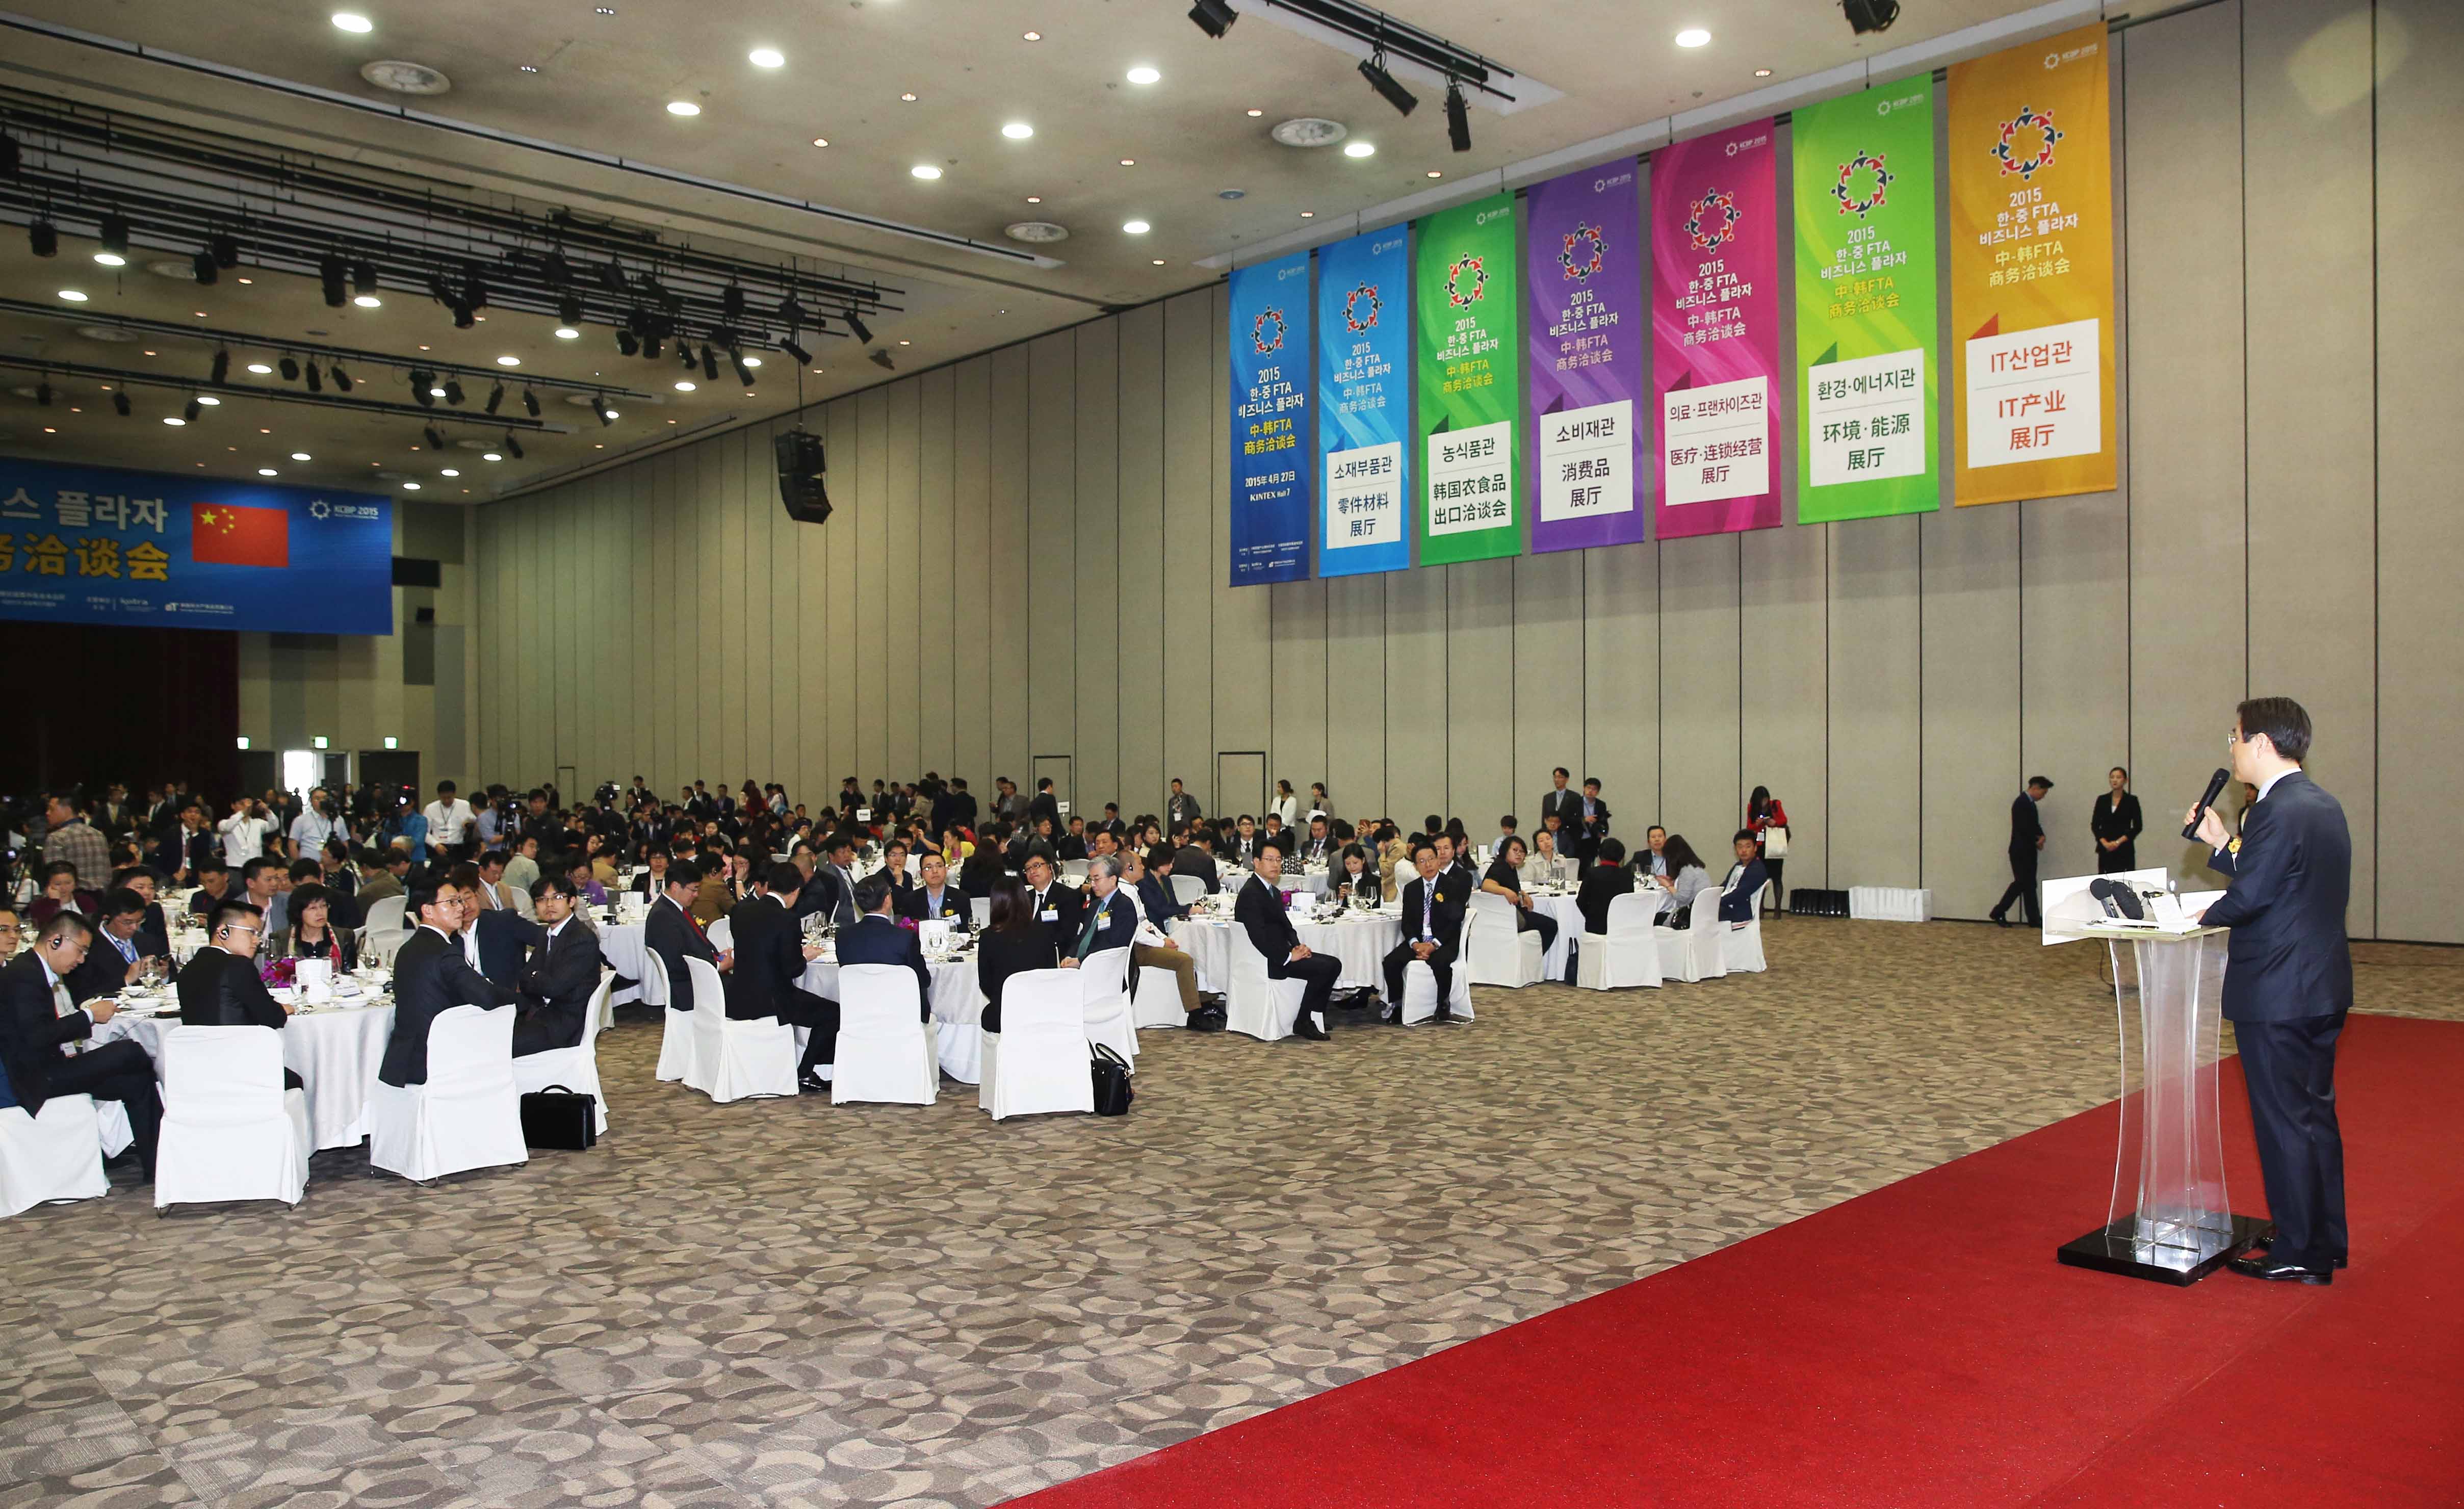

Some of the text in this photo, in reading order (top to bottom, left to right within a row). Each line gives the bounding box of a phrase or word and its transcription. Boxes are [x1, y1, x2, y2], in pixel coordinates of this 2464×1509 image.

[2009, 187, 2042, 207] 2015
[2032, 201, 2060, 220] FTA
[1847, 226, 1875, 245] 2015
[1979, 213, 2079, 246] 비즈니스 플라자
[1867, 241, 1890, 256] FTA
[1699, 259, 1724, 277] 2015
[1821, 251, 1907, 281] 비즈니스 플라자
[1717, 273, 1738, 289] FTA
[1571, 290, 1593, 306] 2015
[1676, 283, 1752, 311] 비즈니스 플라자
[1586, 302, 1605, 316] FTA
[1456, 317, 1475, 331] 2015
[1470, 329, 1487, 341] FTA
[1549, 311, 1619, 337] 비즈니스 플라자
[1352, 342, 1370, 356] 2015
[1365, 354, 1381, 365] FTA
[1437, 338, 1498, 361] 비즈니스 플라자
[1991, 340, 2072, 373] IT산업관
[1258, 366, 1280, 384] 2015
[1334, 362, 1391, 383] 비즈니스 플라자
[1274, 381, 1292, 396] FTA
[1818, 368, 1915, 401] 환경·에너지관
[1238, 393, 1304, 419] 비즈니스 플라자
[1999, 389, 2066, 418] IT产业
[1556, 417, 1615, 443] 소비재관
[1823, 413, 1910, 443] 环境·能源
[2010, 424, 2055, 450] 展厅
[1443, 437, 1495, 462] 농식품관
[1848, 447, 1885, 471] 展厅
[1334, 455, 1392, 479] 소재부품관
[1562, 458, 1610, 482] 消费品
[1702, 465, 1730, 485] 展厅
[1250, 491, 1276, 502] KINTEX
[1434, 474, 1506, 501] 韩国农食品
[1570, 486, 1601, 508] 展厅
[2, 487, 169, 533] 스 플라자
[358, 507, 378, 515] 2015
[1338, 491, 1389, 514] 零件材料
[1435, 499, 1506, 525] 出口洽谈会
[1351, 518, 1376, 537] 展厅
